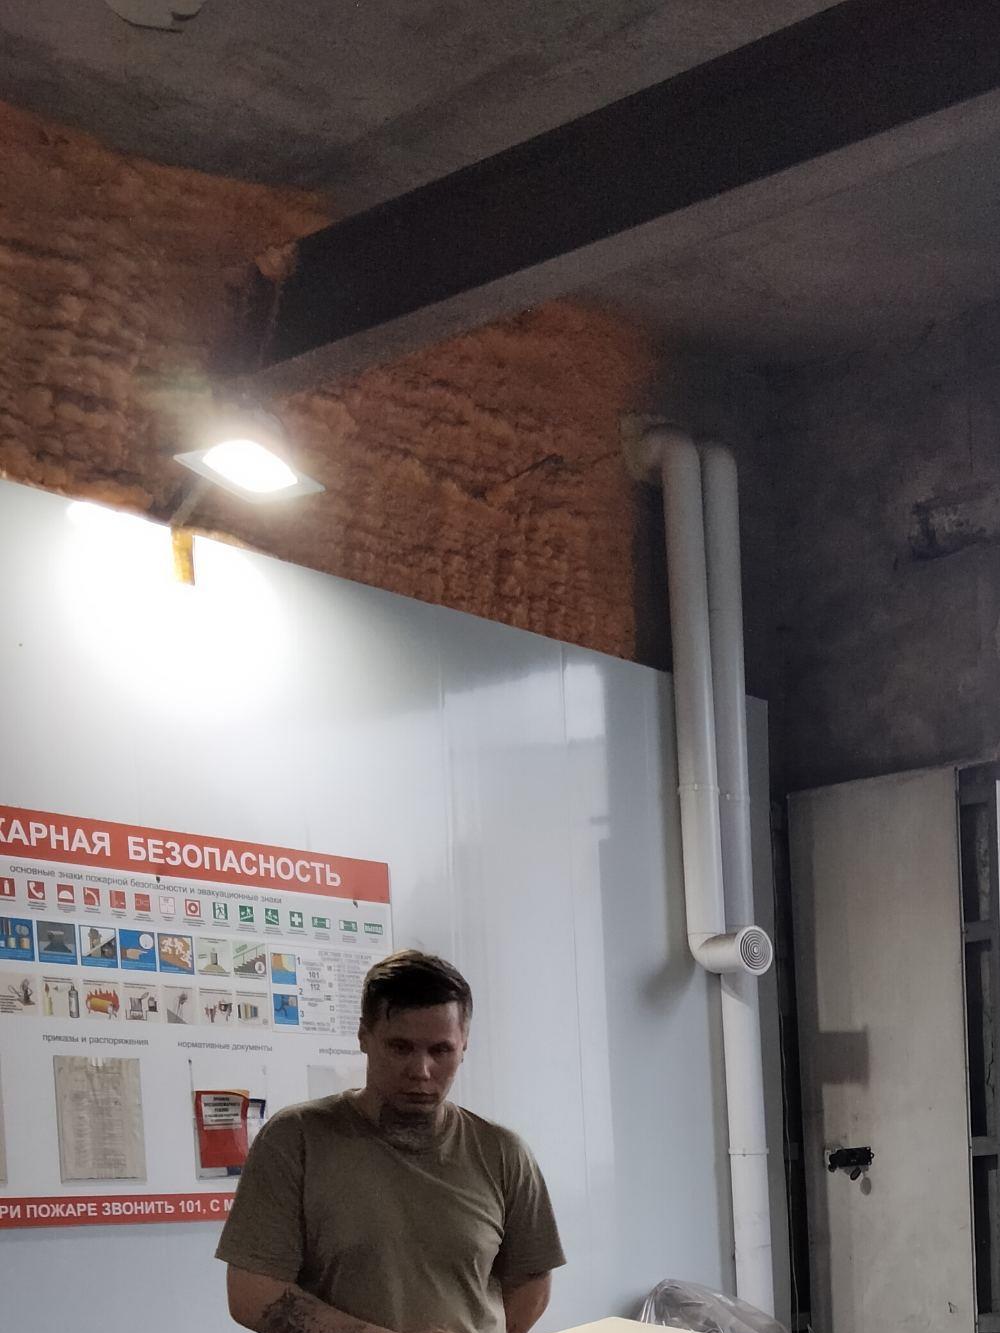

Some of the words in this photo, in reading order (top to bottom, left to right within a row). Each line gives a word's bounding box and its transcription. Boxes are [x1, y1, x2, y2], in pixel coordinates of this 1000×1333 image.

[128, 836, 342, 887] БЕЗОПАСНОСТЬ
[10, 865, 55, 878] основные
[58, 869, 83, 881] знаки
[86, 873, 128, 887] пожарной
[130, 878, 188, 895] безопасности
[197, 888, 258, 902] эвакуационные
[262, 895, 282, 904] знаки
[42, 1034, 79, 1043] приказы
[89, 1036, 149, 1047] распоряжения
[177, 1041, 231, 1050] нормативные
[231, 1043, 273, 1053] документы
[26, 1203, 98, 1218] ПОЖАРЕ
[102, 1201, 175, 1216] ЗВОНИТЬ
[178, 1199, 207, 1214] 101,
[209, 1199, 221, 1212] С
